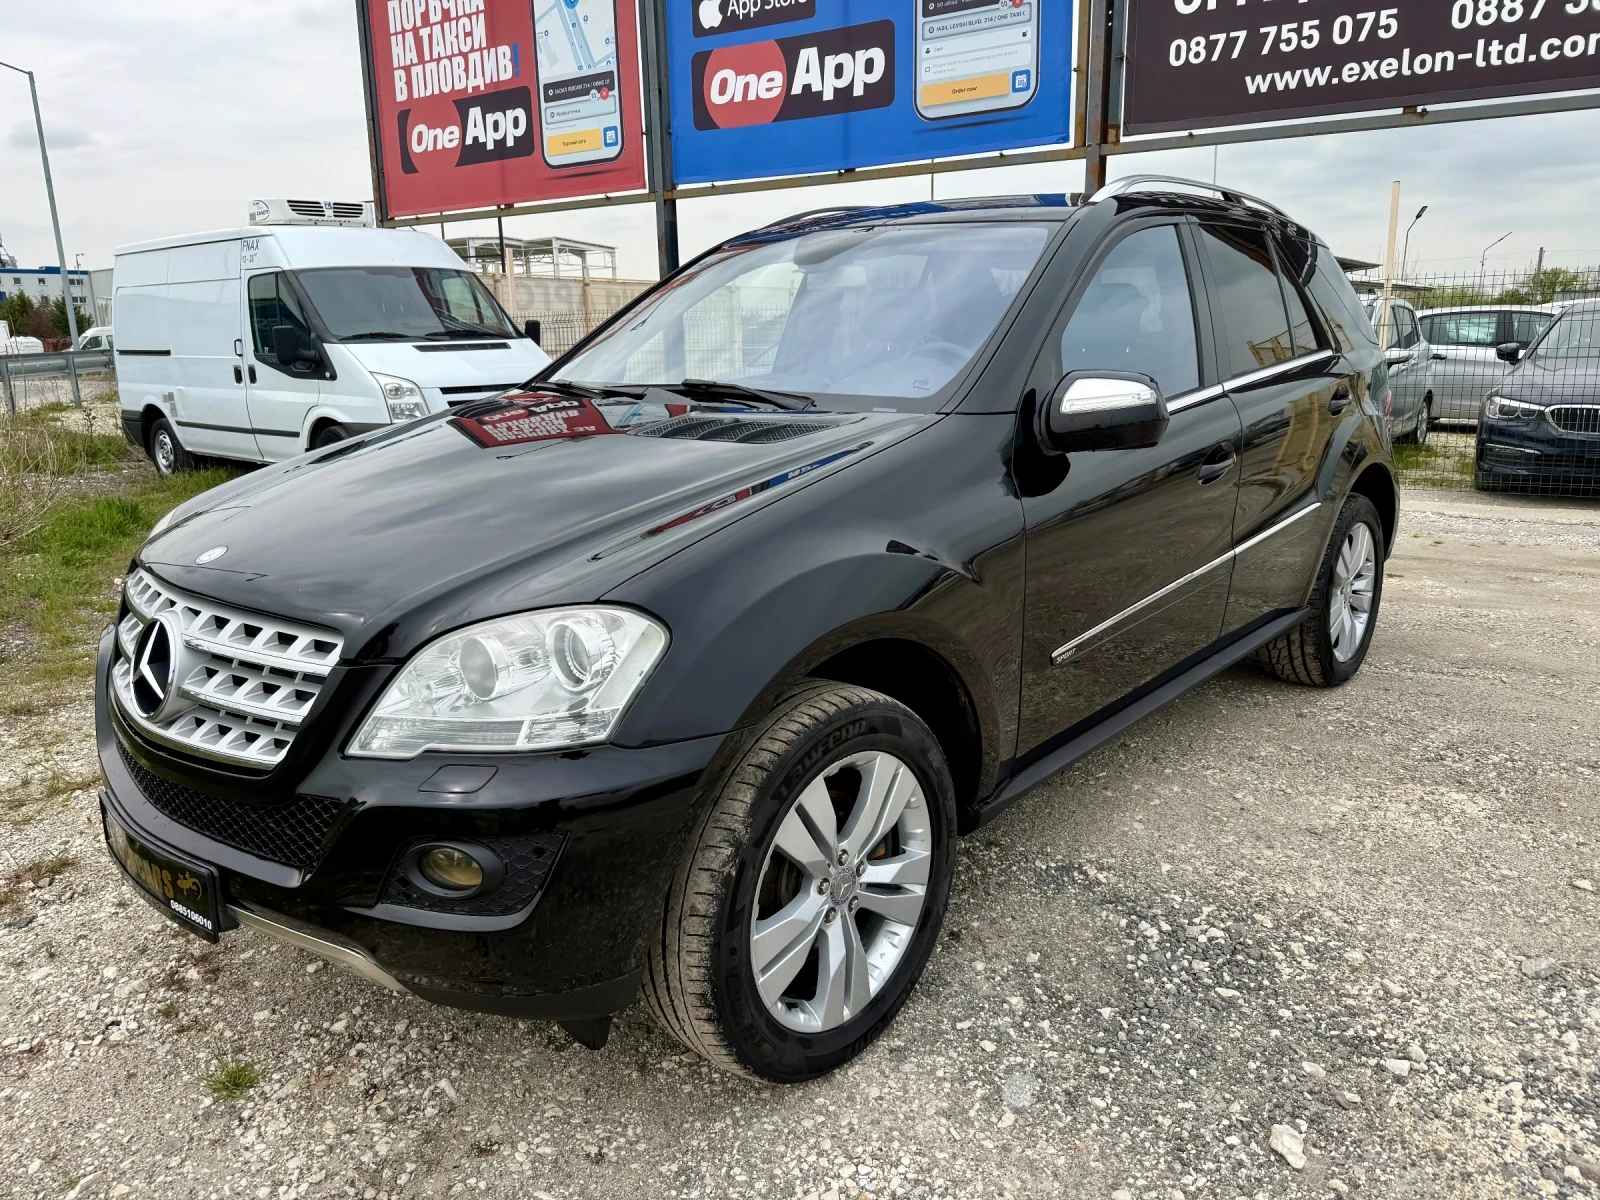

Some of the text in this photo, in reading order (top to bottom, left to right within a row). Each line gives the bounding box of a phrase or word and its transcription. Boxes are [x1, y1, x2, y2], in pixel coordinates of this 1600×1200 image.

[390, 12, 487, 68] НА ТАКСИ
[1168, 8, 1399, 67] 0877 755 075
[394, 42, 520, 102] В ПЛОВДИВ!
[710, 46, 886, 105] One App
[411, 106, 527, 154] One App
